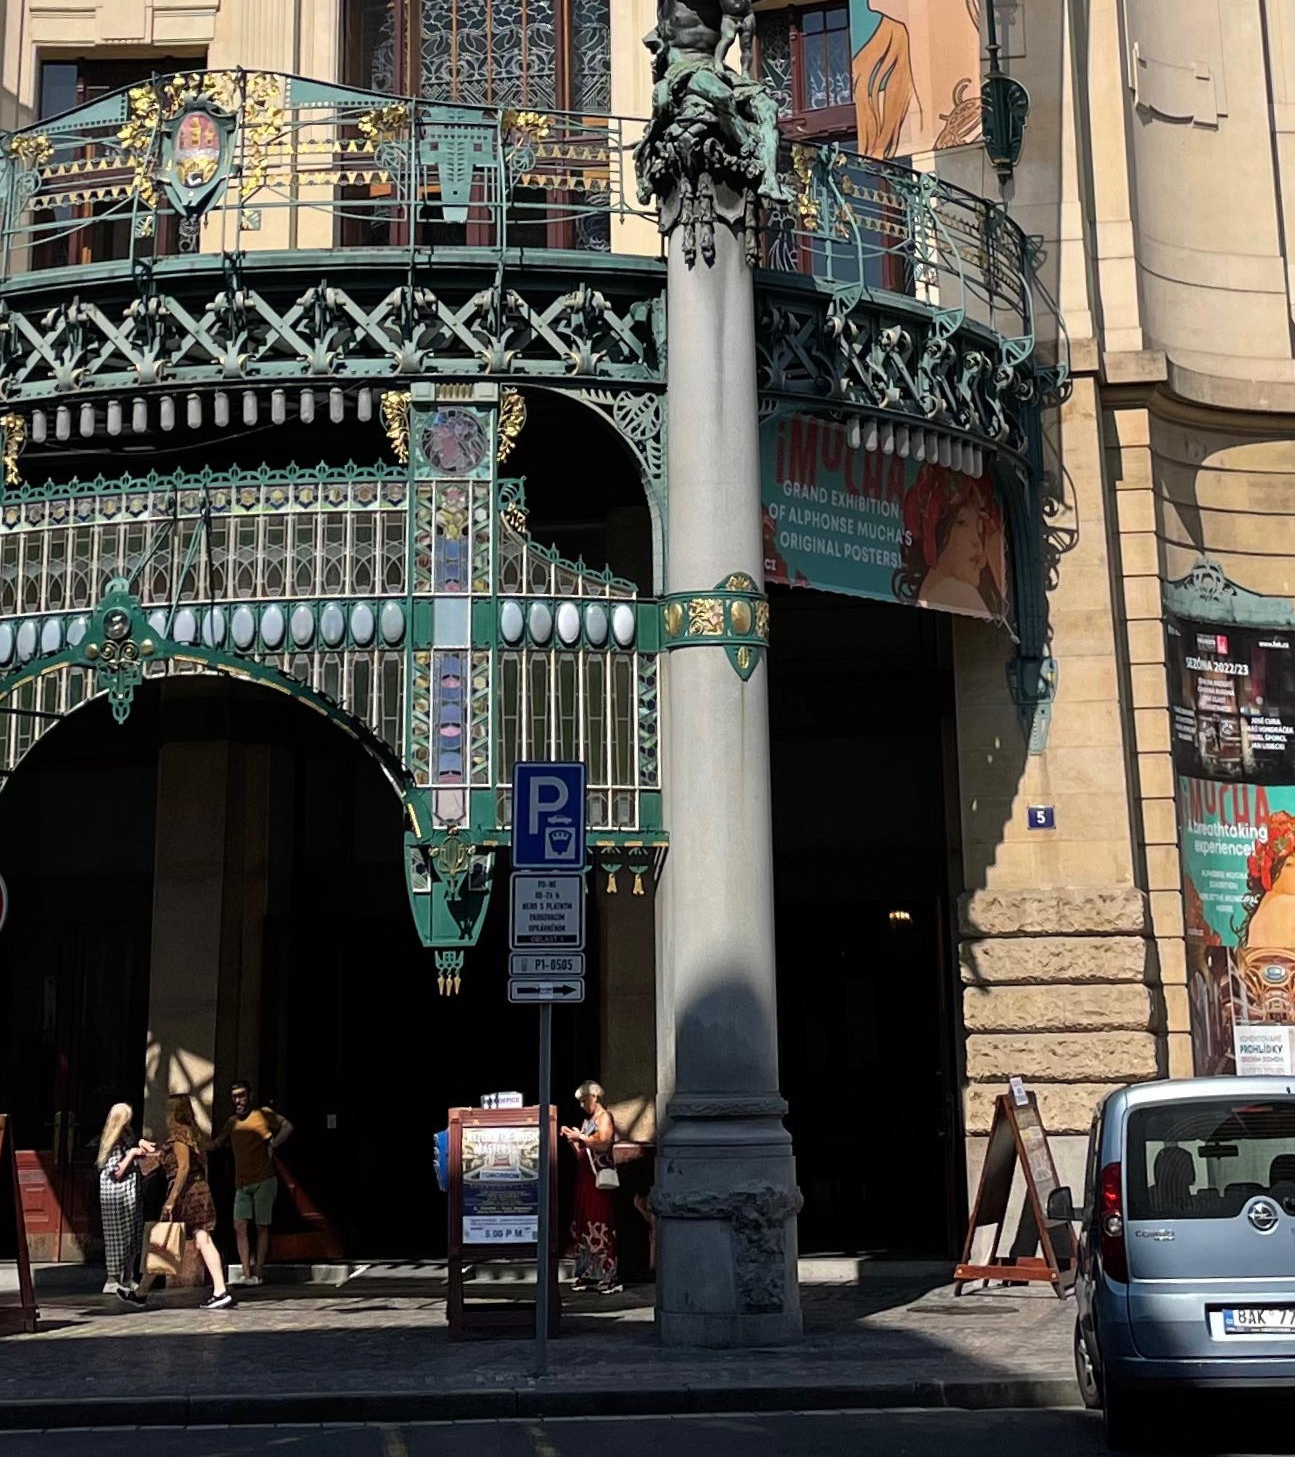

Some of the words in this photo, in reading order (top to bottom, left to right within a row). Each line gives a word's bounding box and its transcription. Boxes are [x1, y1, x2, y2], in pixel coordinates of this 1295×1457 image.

[783, 480, 828, 503] GRAND
[831, 490, 900, 519] EXHIBITION
[768, 503, 786, 520] OF
[788, 507, 854, 535] ALPHONSE
[857, 522, 913, 547] MUCHA'S
[780, 531, 841, 557] ORIGINAL
[844, 543, 903, 569] POSTERS!
[1214, 663, 1249, 675] 2022/23
[529, 776, 569, 835] P
[1036, 810, 1046, 826] 5
[1194, 821, 1269, 843] breathtaking
[1195, 839, 1256, 857] experience!
[535, 959, 573, 971] P1-0505
[1238, 1309, 1266, 1325] 8AK
